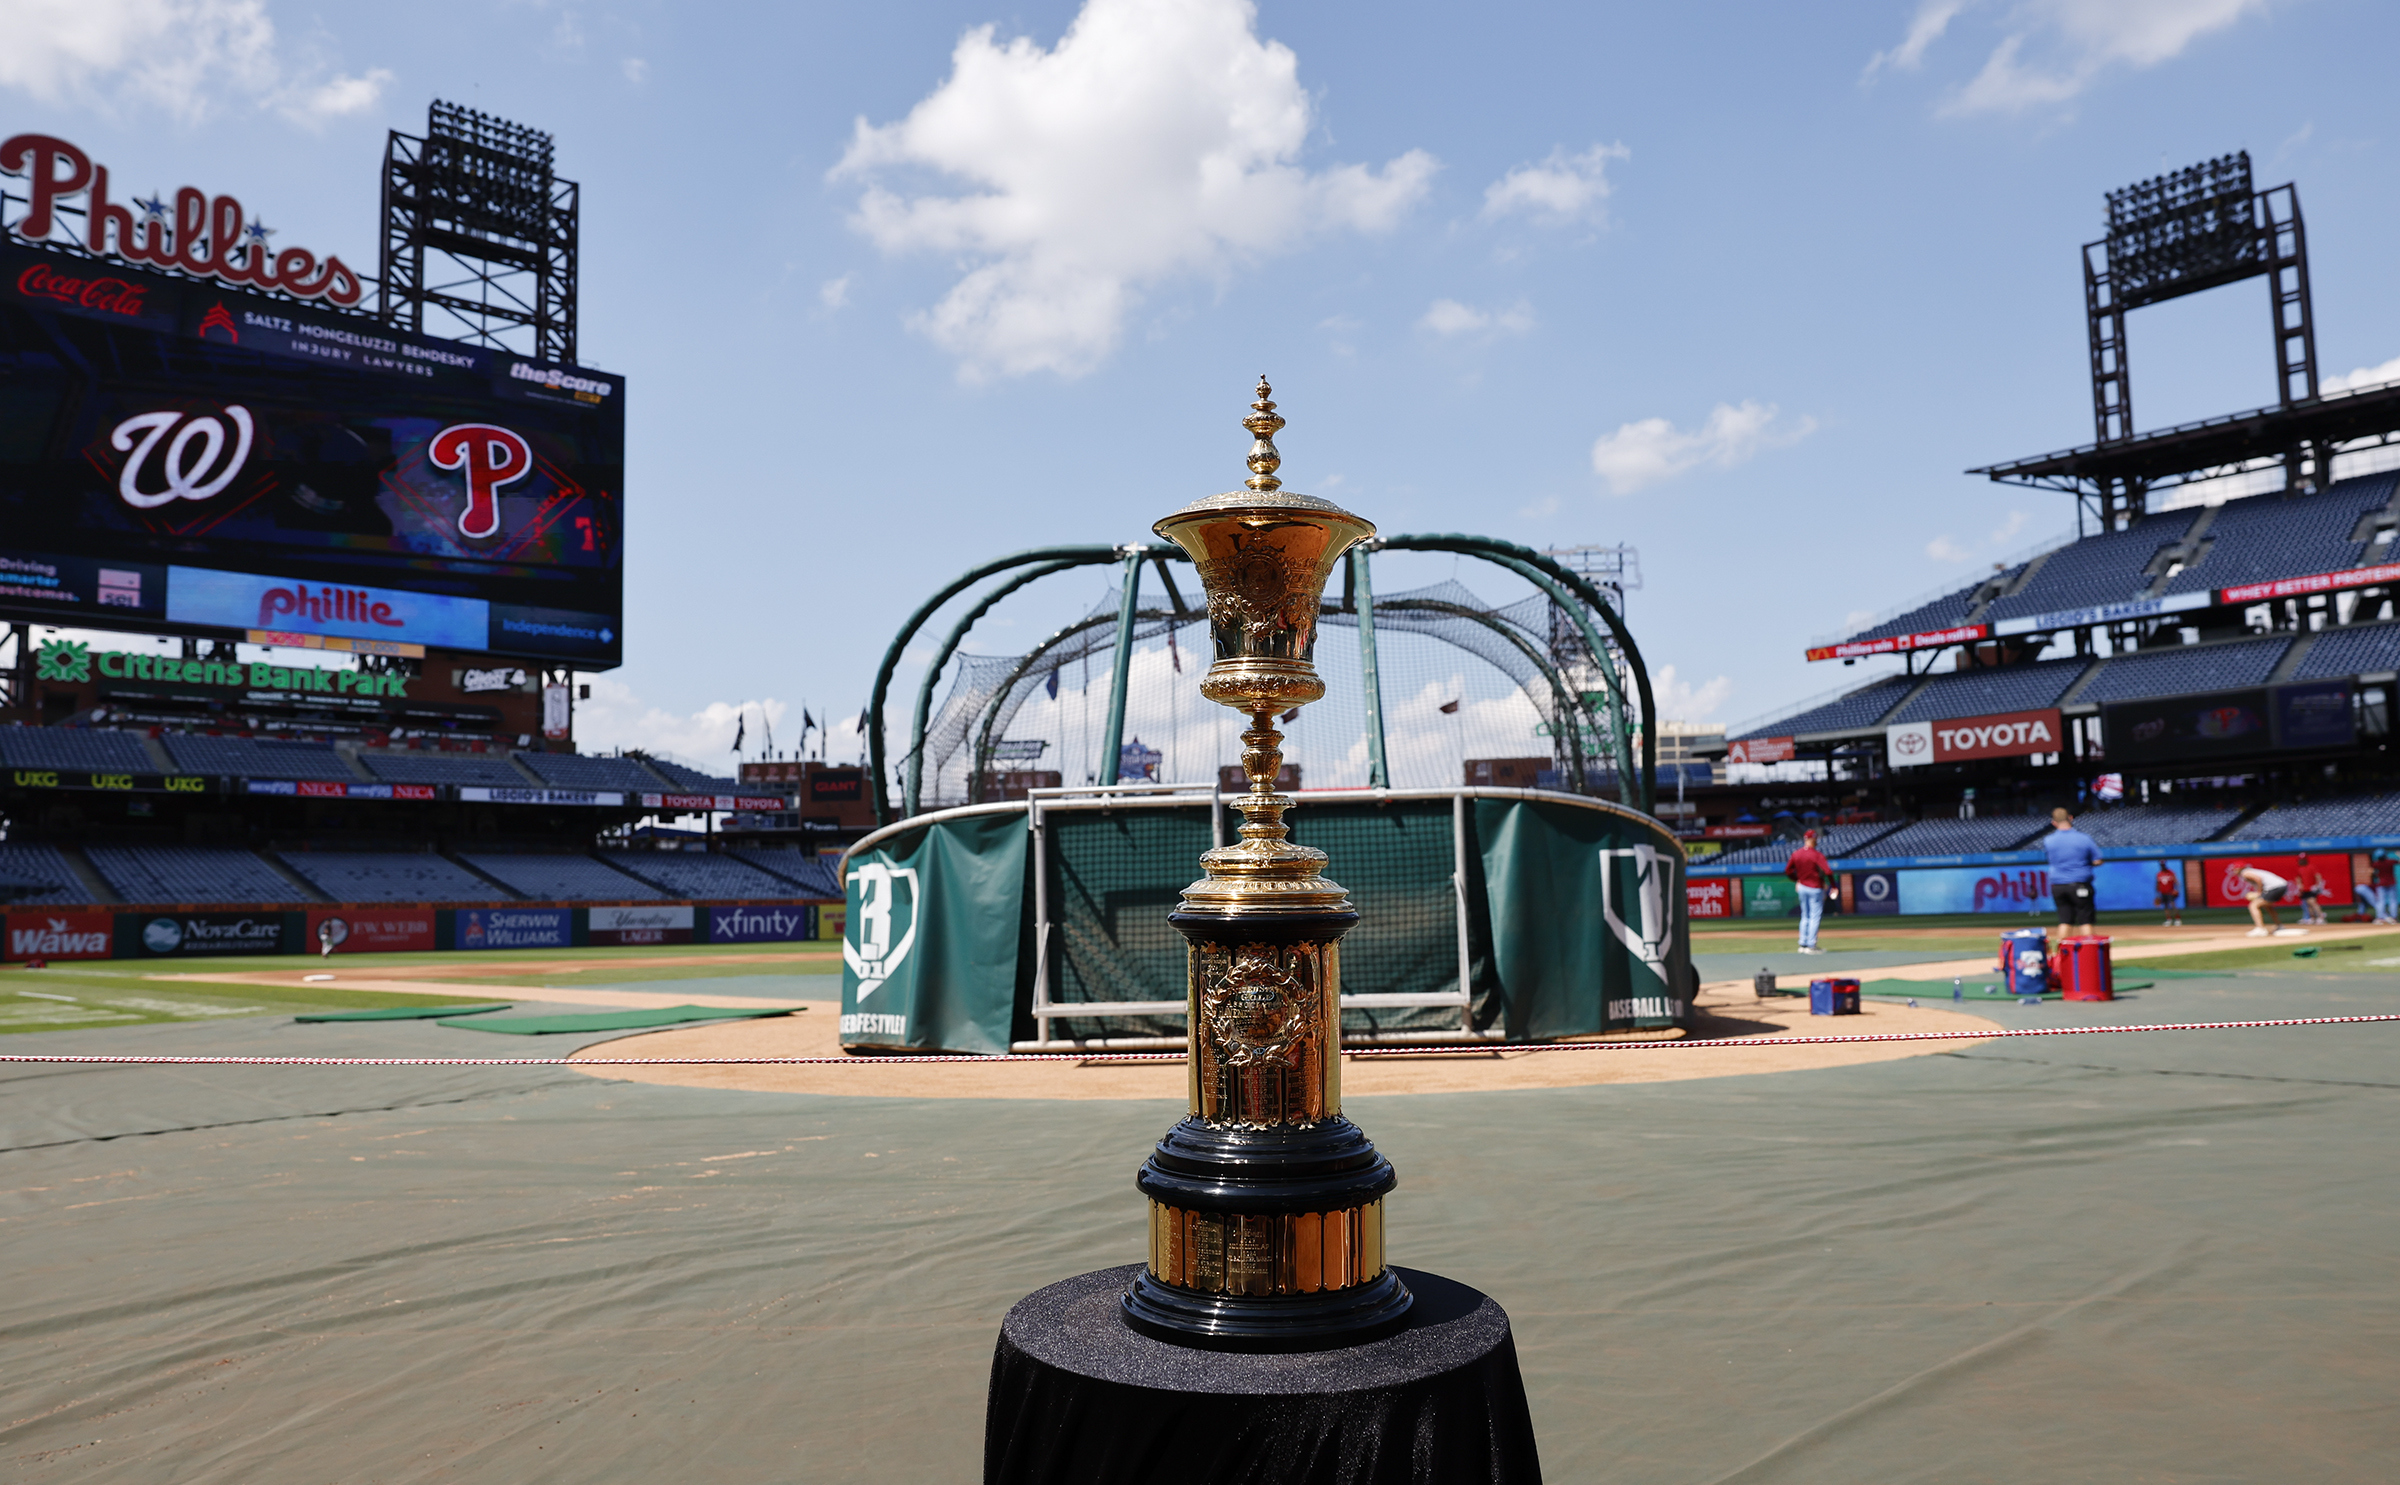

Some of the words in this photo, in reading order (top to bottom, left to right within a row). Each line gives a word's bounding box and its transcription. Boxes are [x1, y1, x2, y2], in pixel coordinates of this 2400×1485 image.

[0, 132, 362, 309] Phillies
[17, 263, 148, 316] Coca-Cola
[244, 311, 292, 333] SALTZ
[298, 323, 397, 354] MONGELUZZI
[402, 343, 476, 369] BENDESKY
[291, 340, 352, 361] INJURY
[363, 354, 434, 377] LAWYERS
[510, 362, 612, 396] theScore
[110, 404, 254, 508] W
[428, 423, 533, 538] P
[2274, 575, 2331, 595] BETTER
[257, 583, 404, 627] phillie
[502, 618, 597, 639] Independence
[98, 651, 244, 686] Citizens
[250, 662, 333, 693] Bank
[338, 669, 407, 698] Park
[1937, 720, 2052, 751] TOYOTA
[14, 771, 59, 788] UKG
[91, 773, 134, 790] UKG
[164, 776, 205, 792] UKG
[815, 780, 857, 792] GIANT
[666, 795, 712, 807] TOYOTA
[738, 797, 782, 809] TOYOTA
[1686, 883, 1725, 901] mple
[1974, 869, 2050, 912] phill
[609, 908, 674, 928] Yuengling
[1687, 900, 1723, 915] alth
[184, 918, 281, 939] NovaCare
[488, 912, 560, 929] SHERWIN
[715, 907, 799, 938] xfinity
[11, 928, 108, 955] Wawa
[620, 930, 664, 943] LAGER
